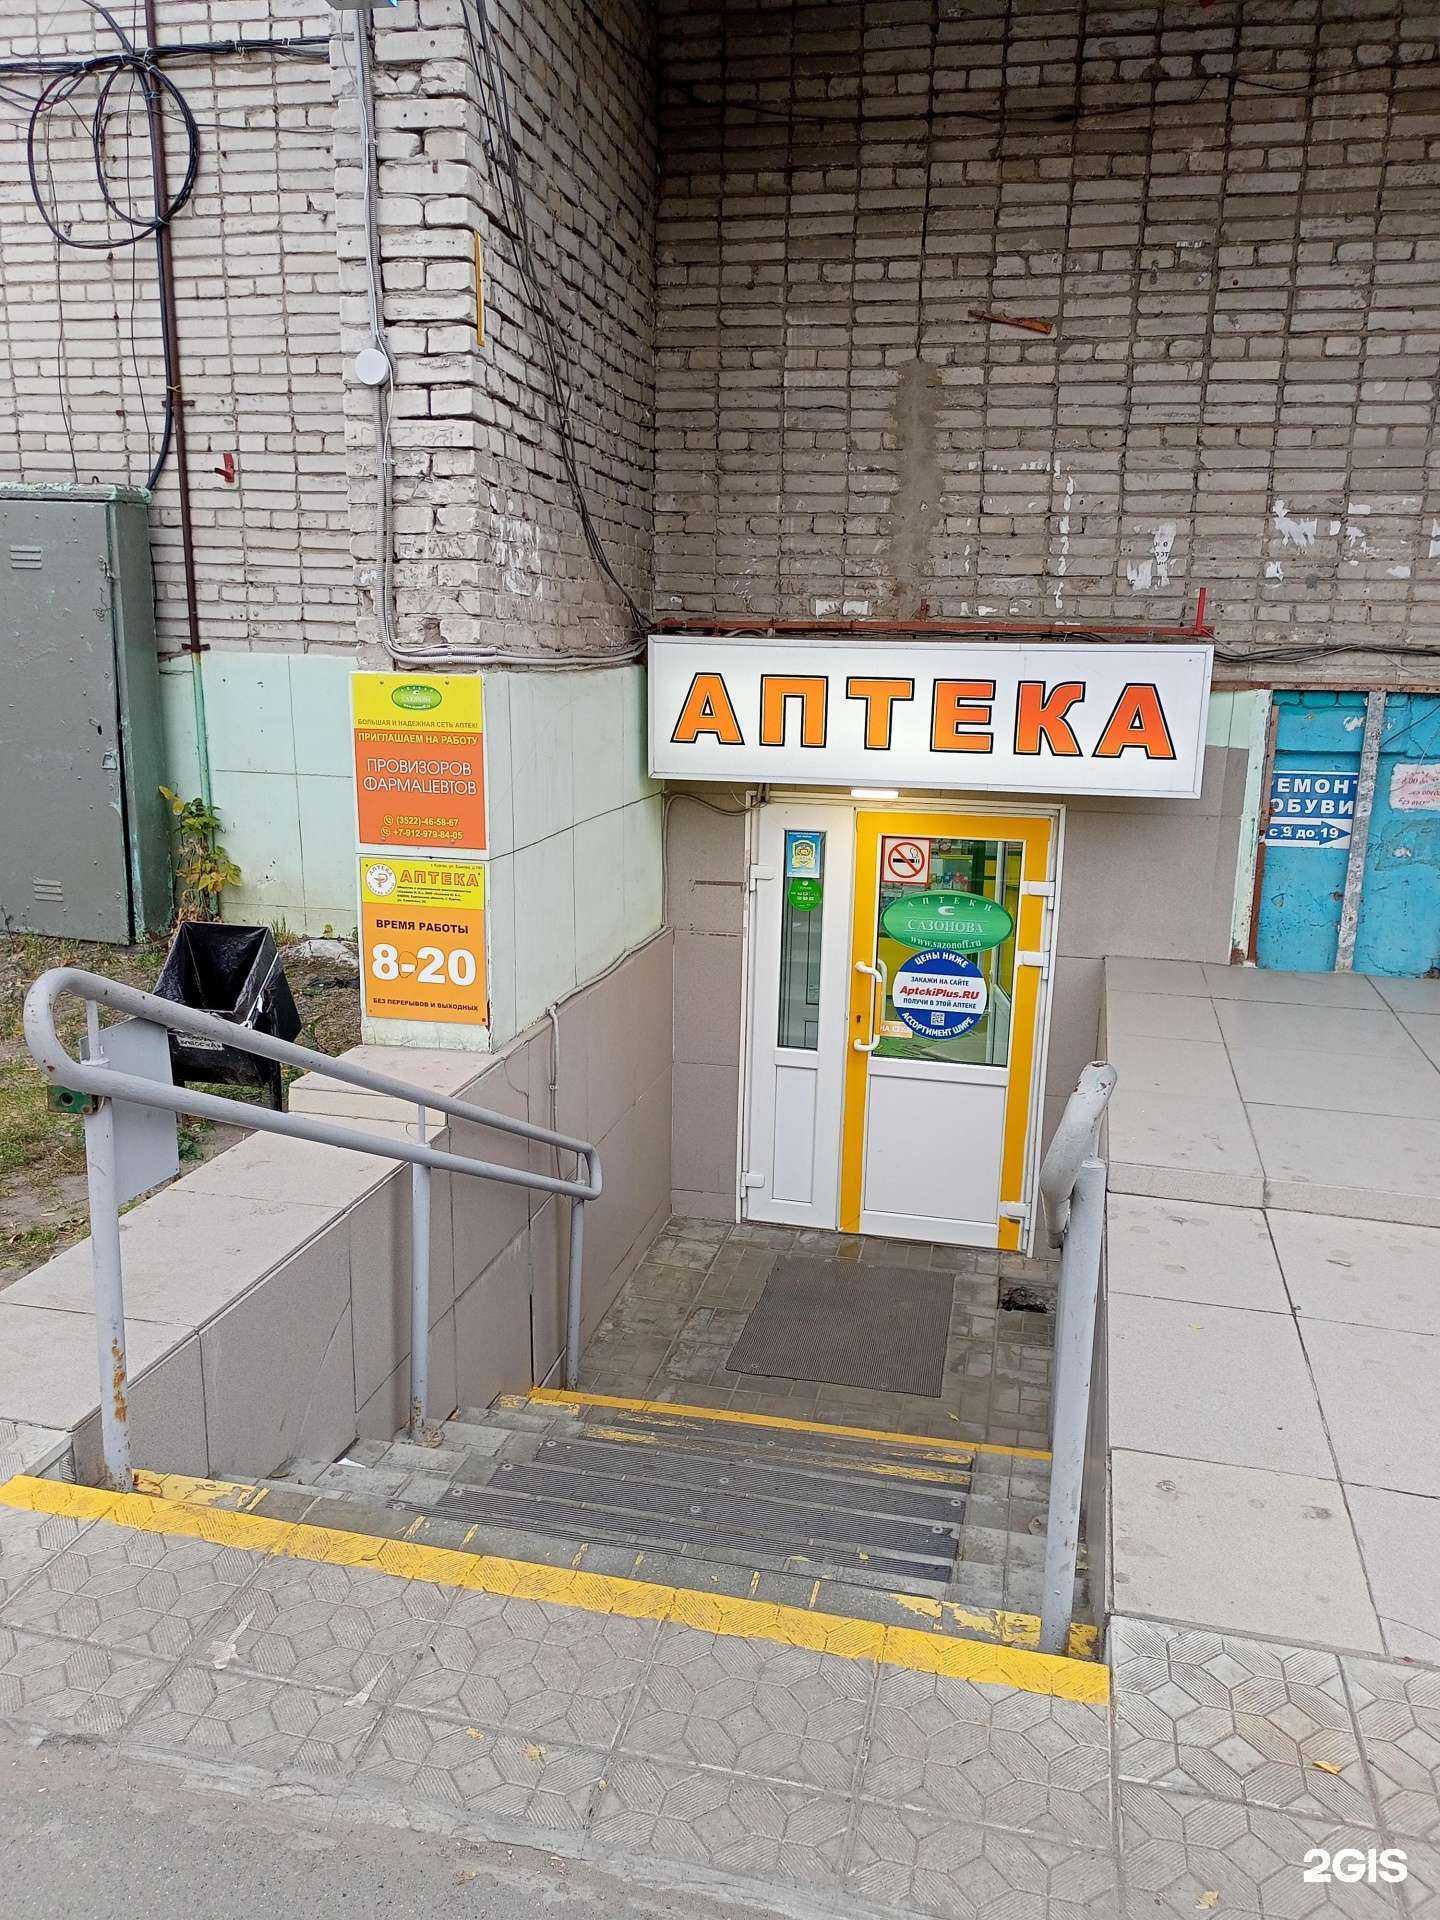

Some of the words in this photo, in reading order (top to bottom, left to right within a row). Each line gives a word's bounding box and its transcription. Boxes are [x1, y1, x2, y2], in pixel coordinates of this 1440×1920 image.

[670, 671, 1178, 760] АПТЕКА
[358, 718, 391, 727] БОЛЬШАЯ
[399, 720, 435, 728] НАДЕЖНАЯ
[436, 721, 454, 729] СЕТЬ
[358, 732, 423, 744] ПРИГЛАШАЕМ
[425, 734, 439, 744] НА
[441, 735, 478, 746] РАБОТУ
[367, 758, 472, 776] ПРОВИЗОРОВ
[363, 776, 477, 795] ФАРМАЦЕВТОВ
[1271, 778, 1357, 794] ЕМОН
[1271, 798, 1354, 815] ОБУВИ
[1269, 828, 1278, 837] с
[1296, 829, 1316, 839] до
[1320, 827, 1339, 839] 19
[400, 869, 479, 887] АПТЕКА
[908, 896, 992, 912] АПТЕКИ
[376, 919, 416, 930] ВРЕМЯ
[418, 922, 469, 934] РАБОТЫ
[908, 919, 983, 933] САЗОНОВА
[911, 936, 981, 949] www.sazonoff.ru
[372, 943, 477, 986] 8-20
[915, 952, 940, 966] ЦЕНЫ
[943, 952, 969, 969] НИЖЕ
[911, 976, 937, 984] ЗАКАЖИ
[950, 978, 969, 987] САЙТЕ
[900, 985, 980, 1000] AptekiPlus.RU
[387, 999, 429, 1008] ПЕРЕРЫВОВ
[437, 1002, 479, 1011] ВЫХОДНЫХ
[903, 998, 928, 1006] ПОЛУЧИ
[936, 999, 951, 1007] ЭТОЙ
[953, 1001, 977, 1010] АПТЕКЕ
[902, 1011, 952, 1037] АССОРТИМЕНТ
[952, 1016, 974, 1034] ШИРЕ
